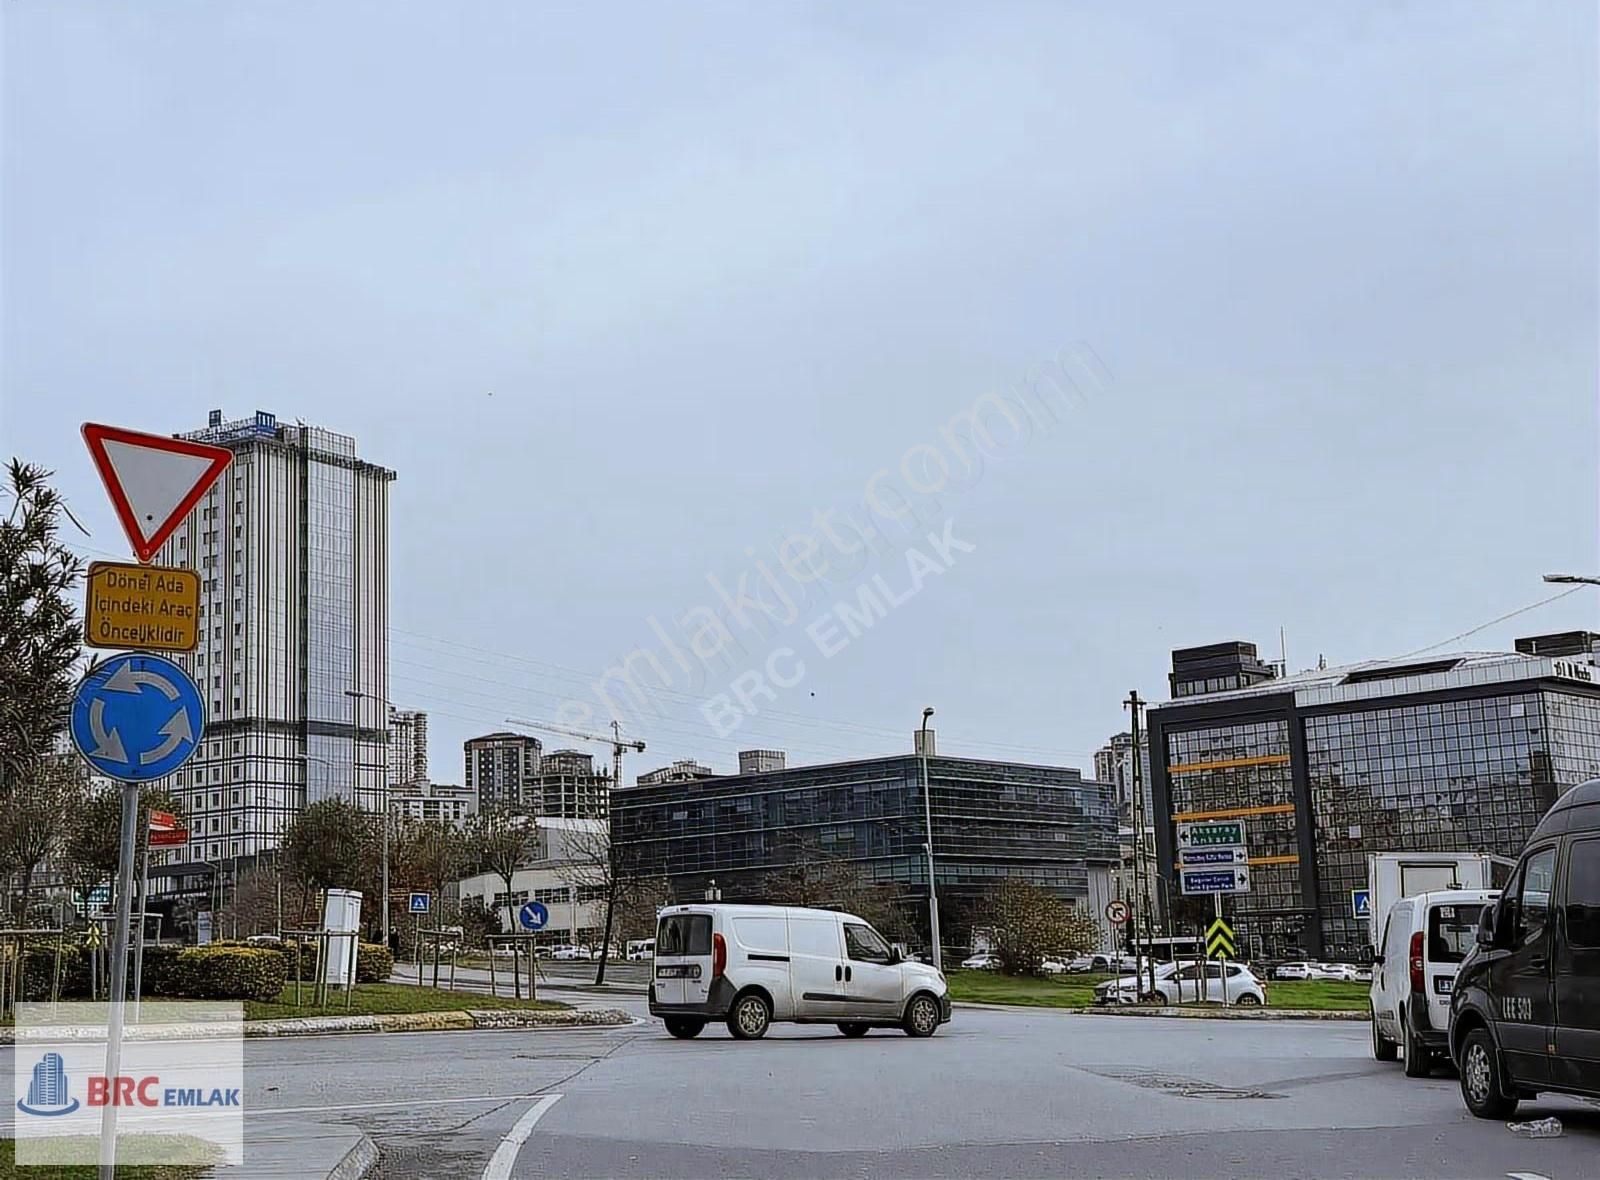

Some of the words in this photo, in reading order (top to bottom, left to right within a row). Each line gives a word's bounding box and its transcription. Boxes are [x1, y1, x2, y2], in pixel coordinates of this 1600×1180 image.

[107, 571, 151, 592] Dönel
[156, 575, 184, 593] Ada
[95, 590, 154, 615] İçindeki
[160, 600, 193, 619] Araç
[100, 616, 184, 643] Önceliklidir
[1191, 826, 1237, 835] Aksaray
[1192, 836, 1235, 845] Ankara
